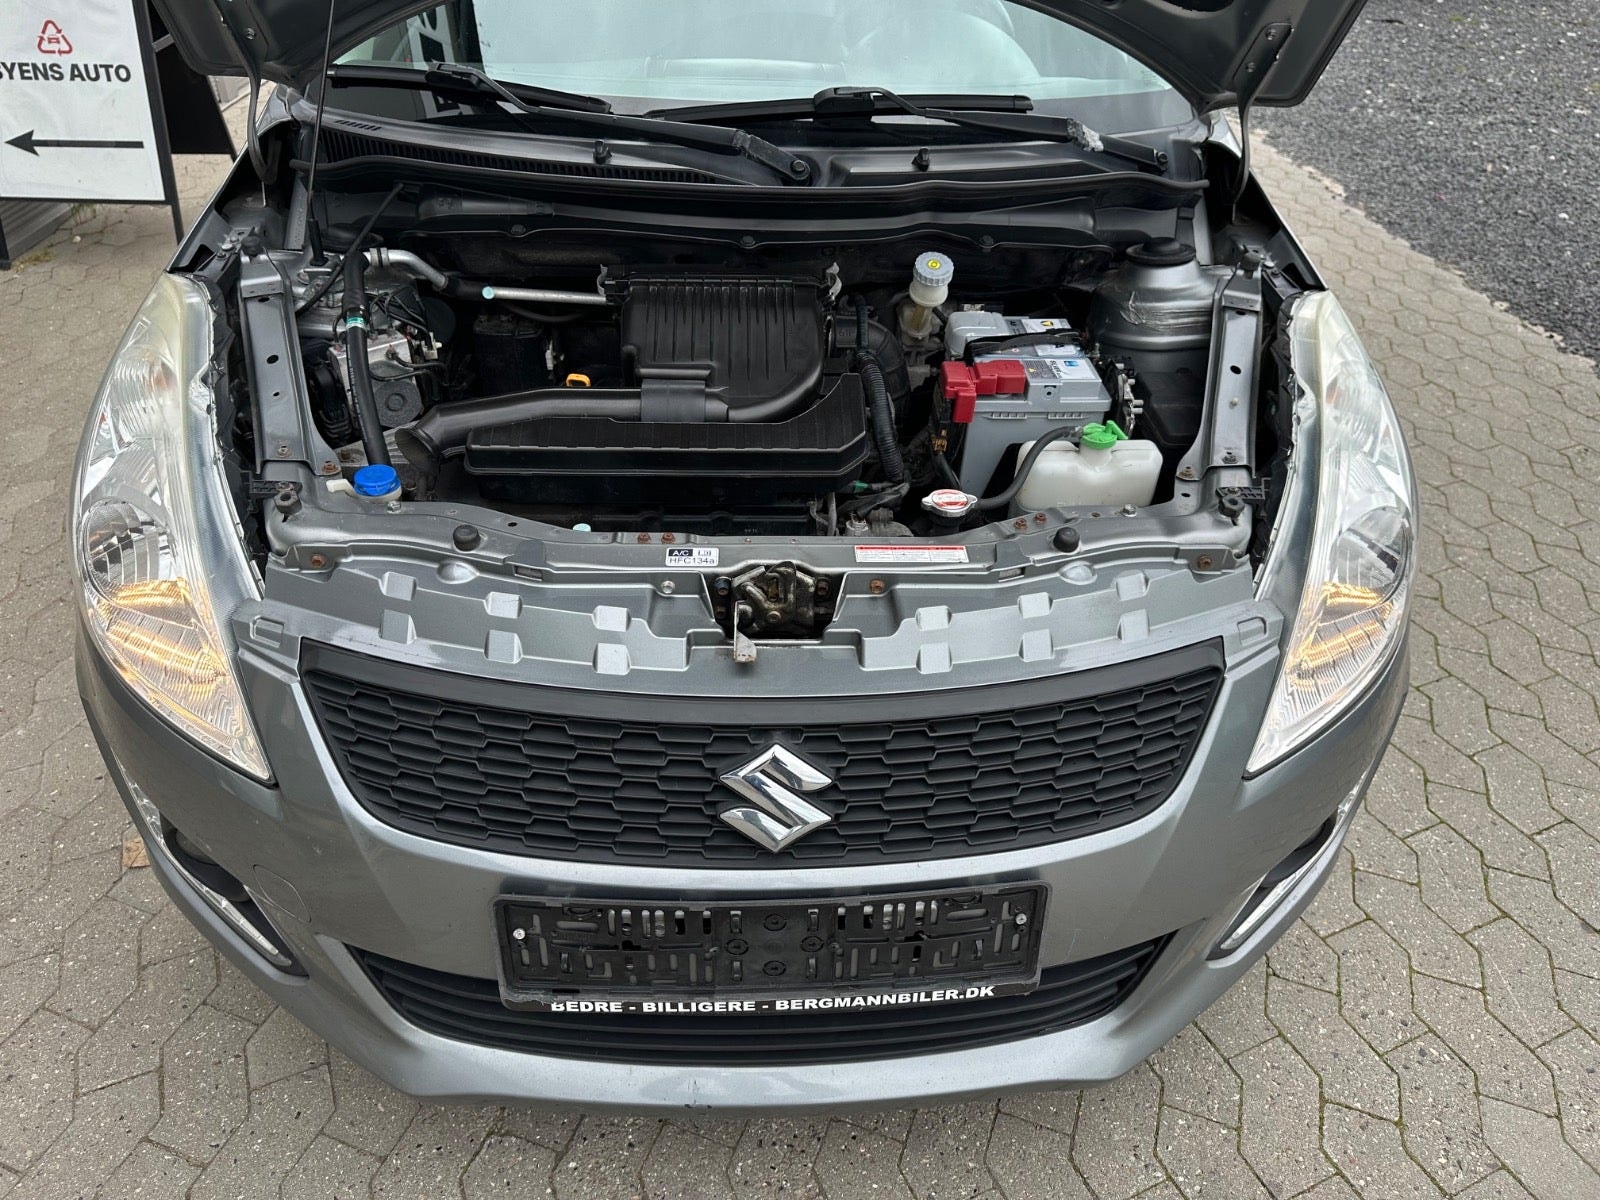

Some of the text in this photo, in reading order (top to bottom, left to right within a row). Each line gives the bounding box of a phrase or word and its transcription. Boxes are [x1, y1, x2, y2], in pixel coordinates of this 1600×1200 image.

[0, 62, 132, 83] YENS AUTO
[669, 557, 715, 565] HFC134a
[551, 1001, 623, 1013] BEDRE
[642, 1001, 756, 1013] BILLIGERE
[775, 985, 995, 1011] BERGMANNBILER.DK
